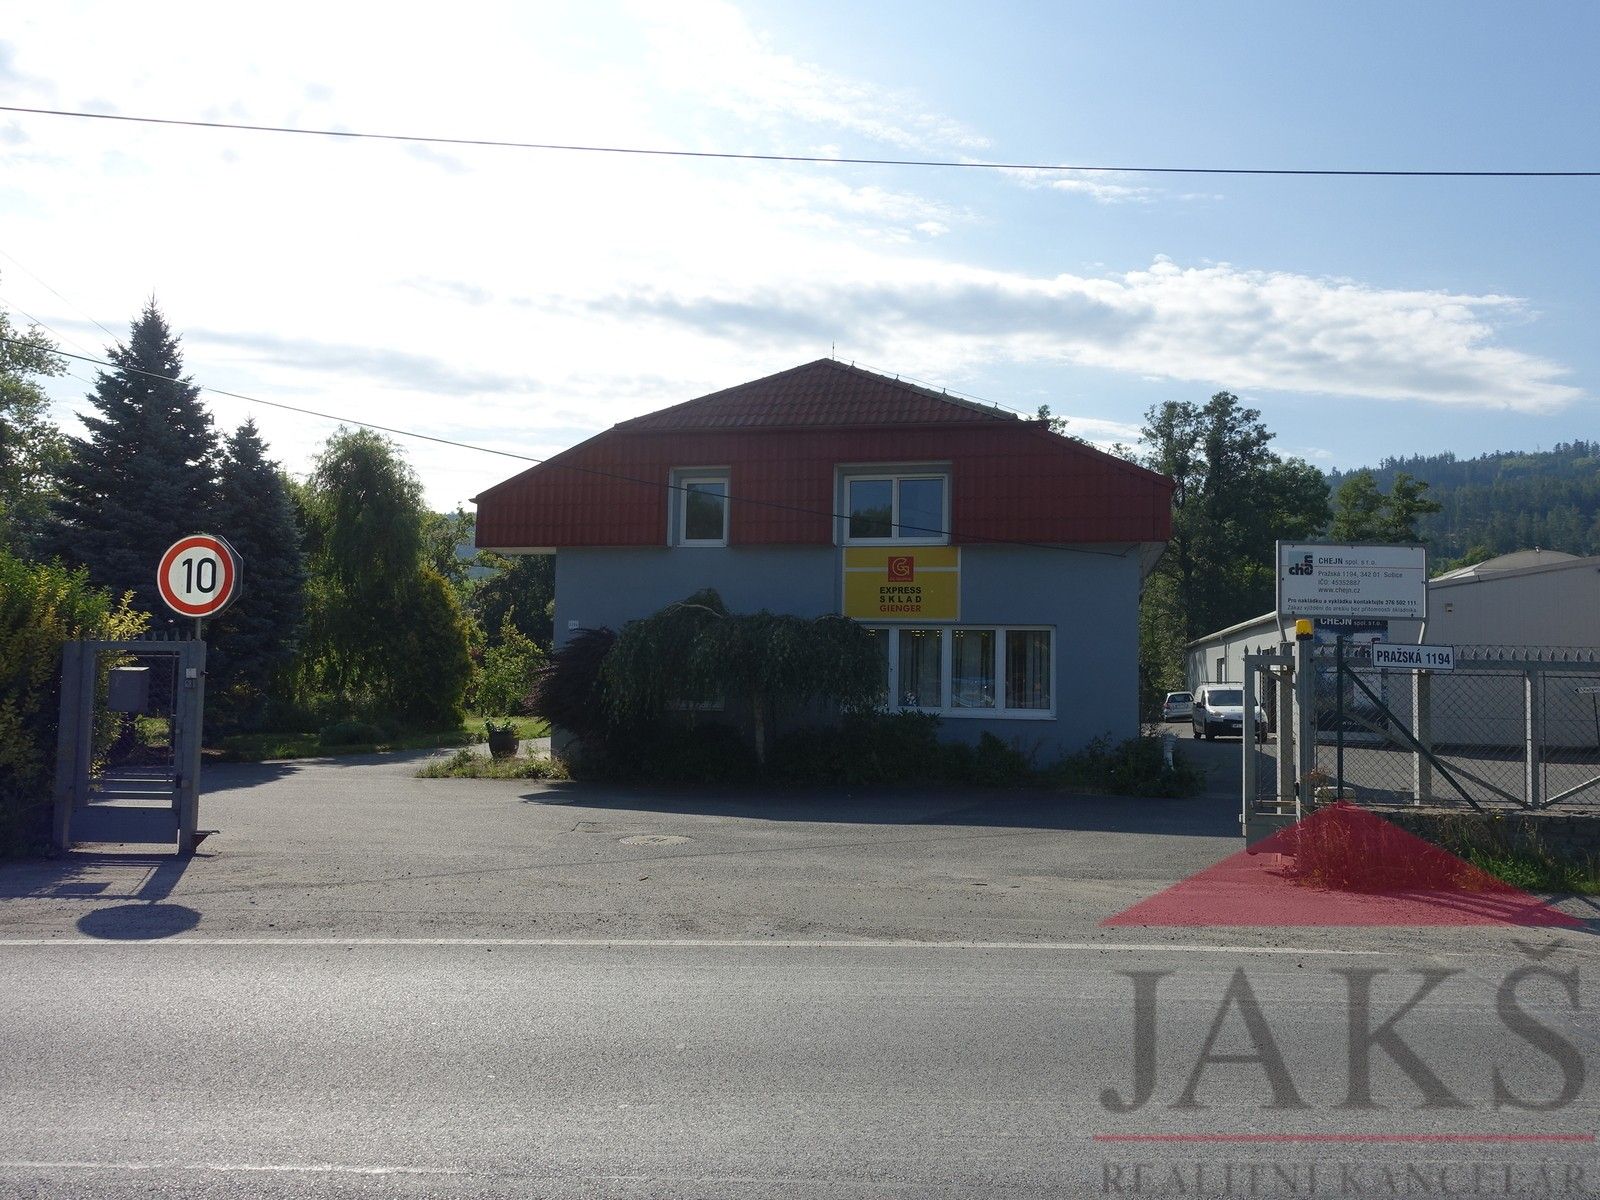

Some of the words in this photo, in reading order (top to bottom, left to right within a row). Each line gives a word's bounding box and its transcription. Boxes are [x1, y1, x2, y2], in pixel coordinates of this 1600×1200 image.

[1318, 557, 1343, 565] CHEJN
[182, 557, 217, 594] 10
[879, 586, 922, 595] EXPRESS
[879, 604, 921, 613] GIENGER
[1376, 648, 1422, 664] PRAŽSKÁ
[1425, 653, 1450, 665] 1194
